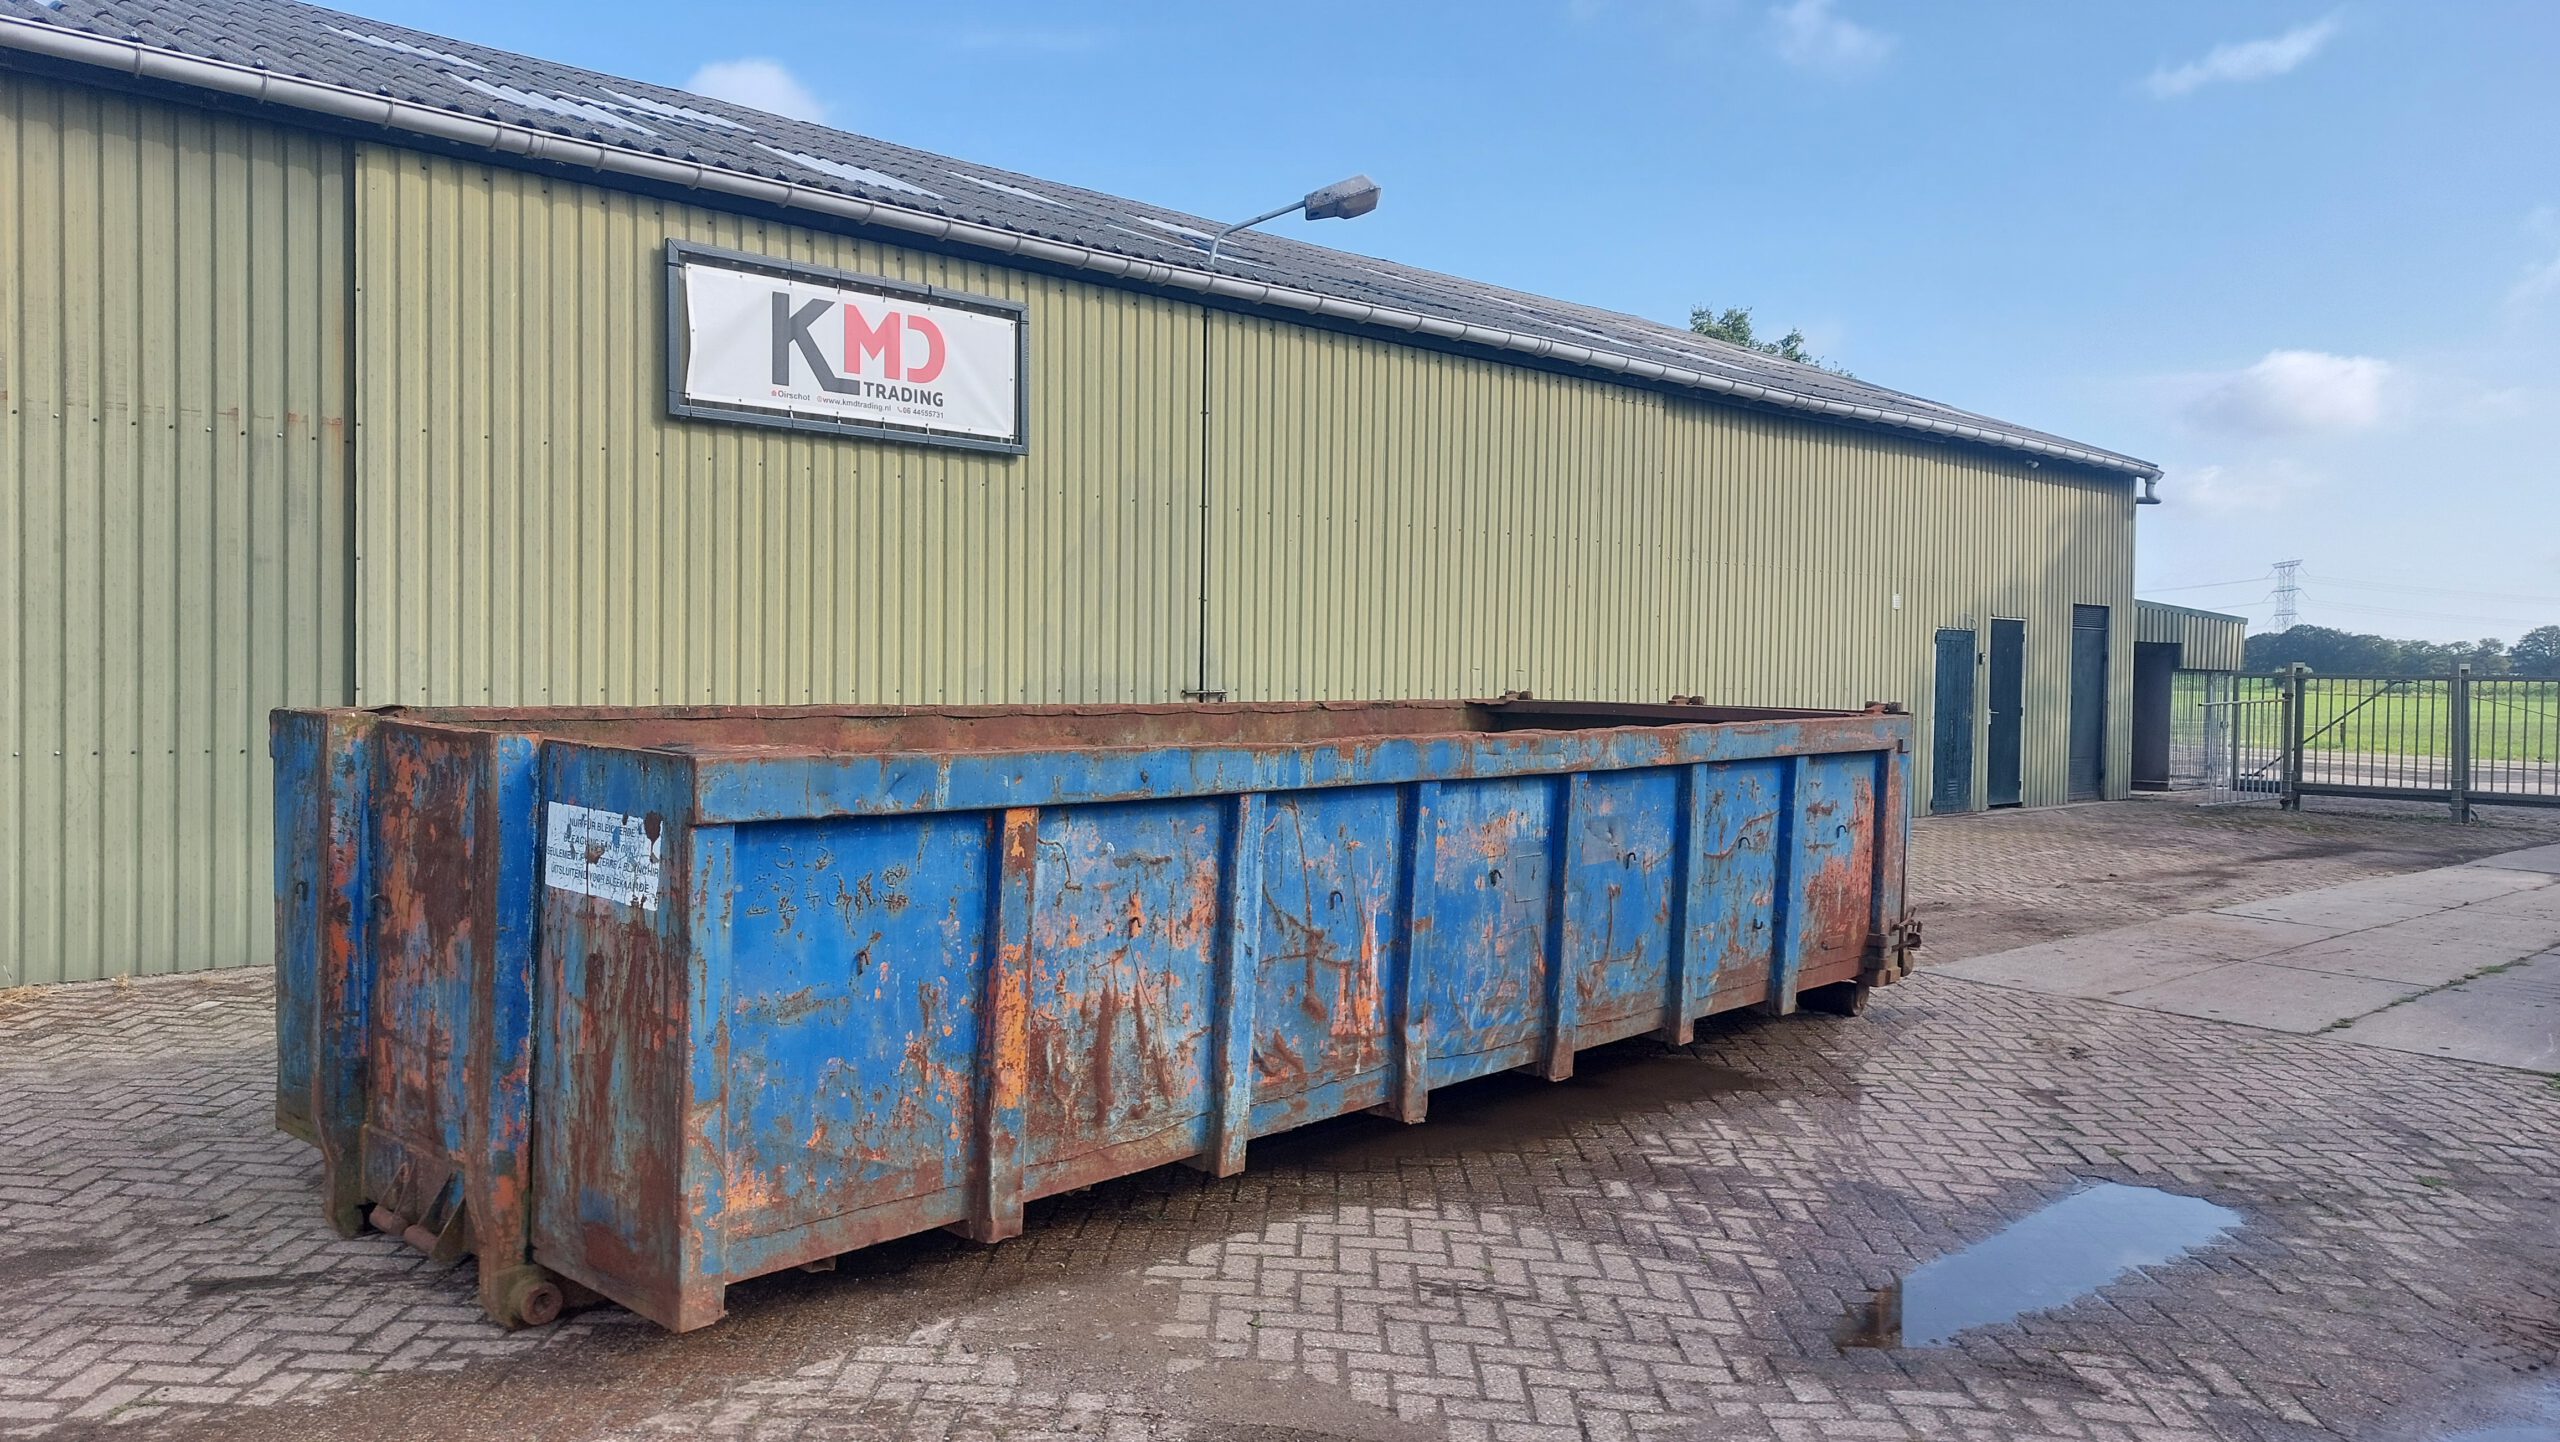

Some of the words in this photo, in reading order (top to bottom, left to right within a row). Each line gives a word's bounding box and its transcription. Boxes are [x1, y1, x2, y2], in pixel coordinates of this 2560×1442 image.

[772, 291, 946, 396] KMD
[778, 390, 810, 402] Oirschot
[822, 397, 892, 412] www.kmdtrading.nl
[902, 407, 911, 415] 06
[864, 382, 944, 407] TRADING
[597, 824, 635, 838] BLEICERDE
[623, 862, 659, 877] BLNCHIR
